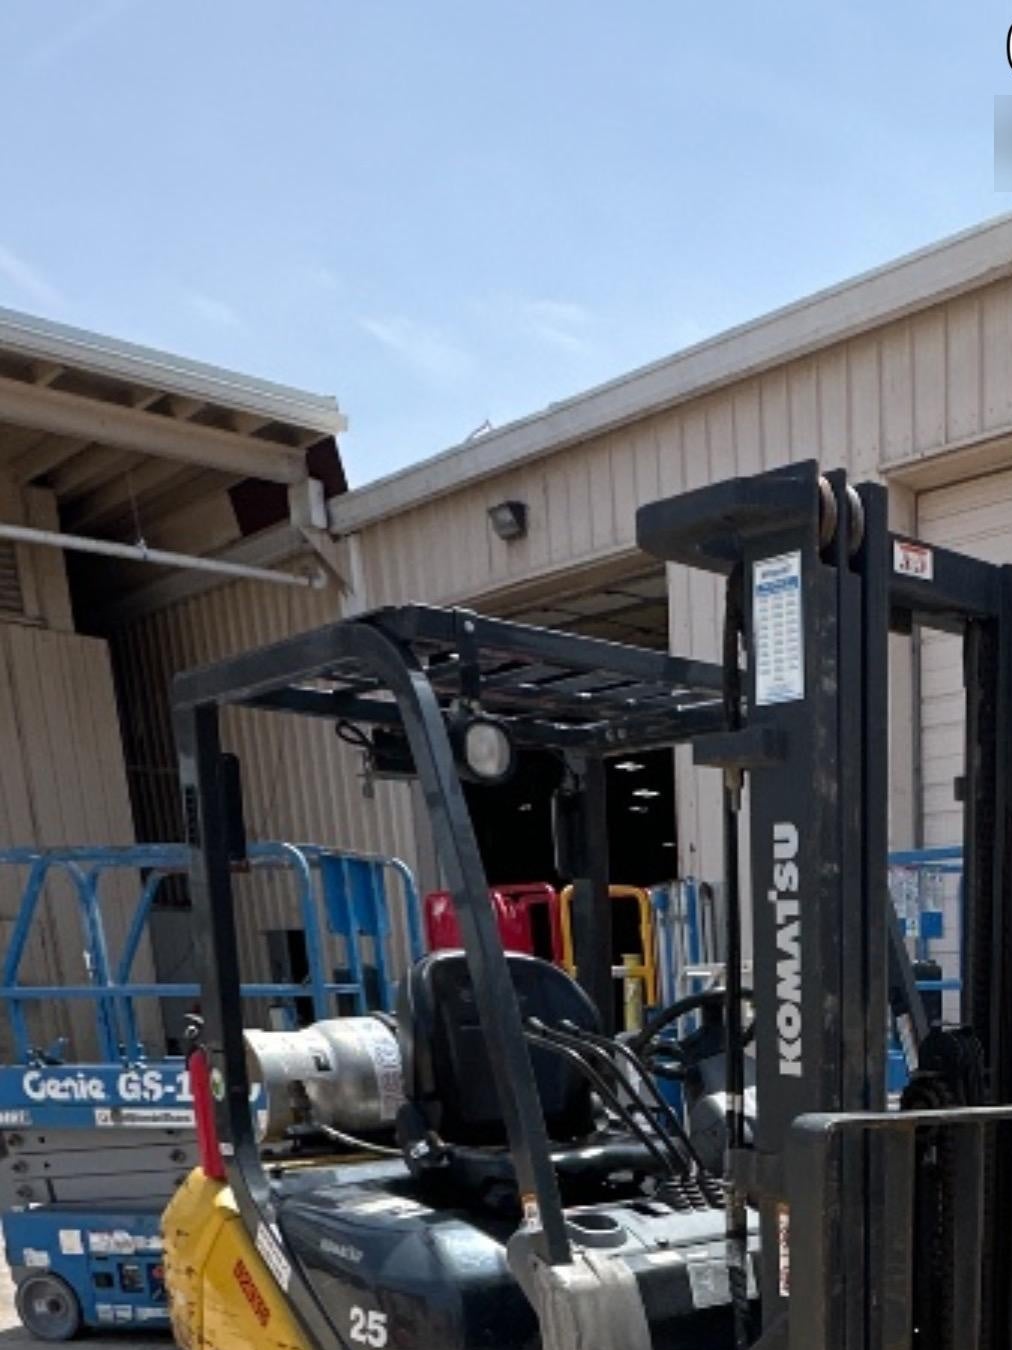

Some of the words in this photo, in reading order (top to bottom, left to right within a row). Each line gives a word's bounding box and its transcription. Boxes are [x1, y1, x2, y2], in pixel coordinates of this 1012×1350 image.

[767, 821, 802, 1077] KOMATSU
[22, 1070, 107, 1100] Genie
[350, 1304, 388, 1348] 25
